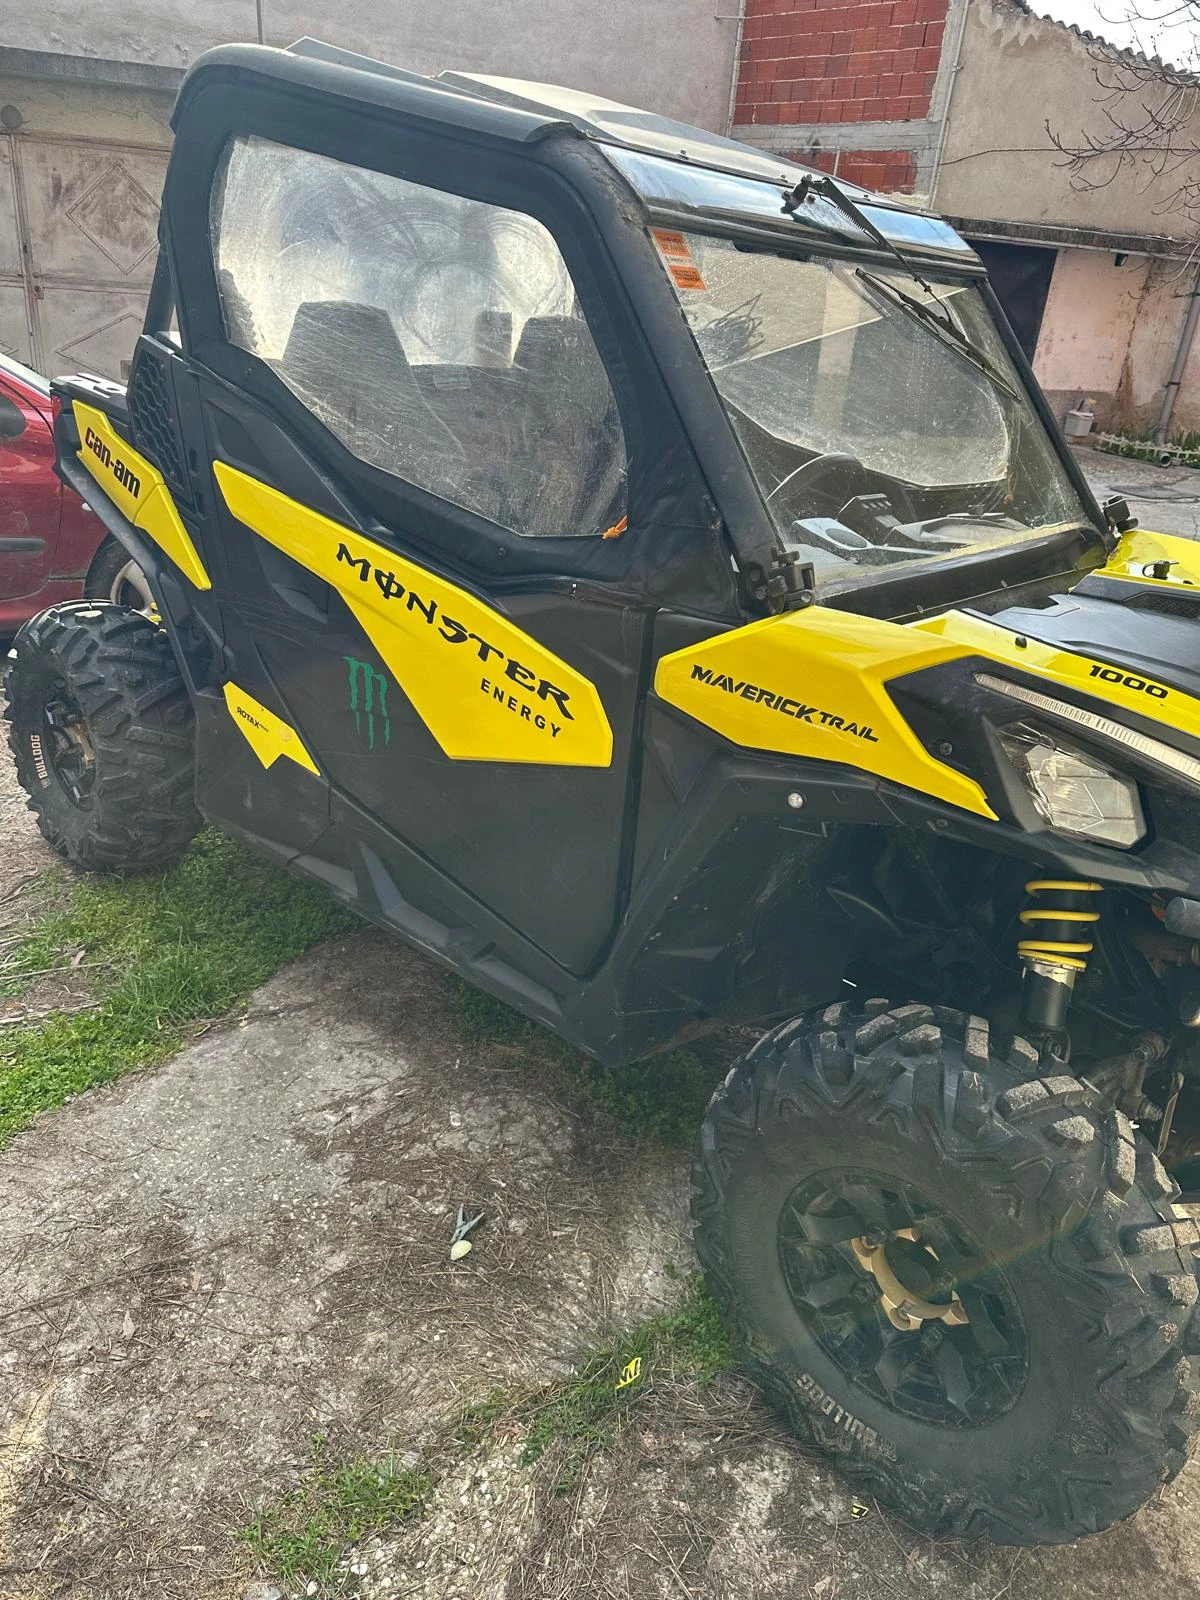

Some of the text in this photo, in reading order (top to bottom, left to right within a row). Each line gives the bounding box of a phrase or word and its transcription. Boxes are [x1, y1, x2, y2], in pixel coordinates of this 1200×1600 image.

[85, 427, 141, 499] can-am
[480, 677, 562, 738] ENERGY
[690, 664, 879, 742] MAVERICK TRAIL
[1089, 664, 1169, 699] 1000
[236, 706, 260, 729] ROTAX
[30, 734, 49, 779] BULLDOG
